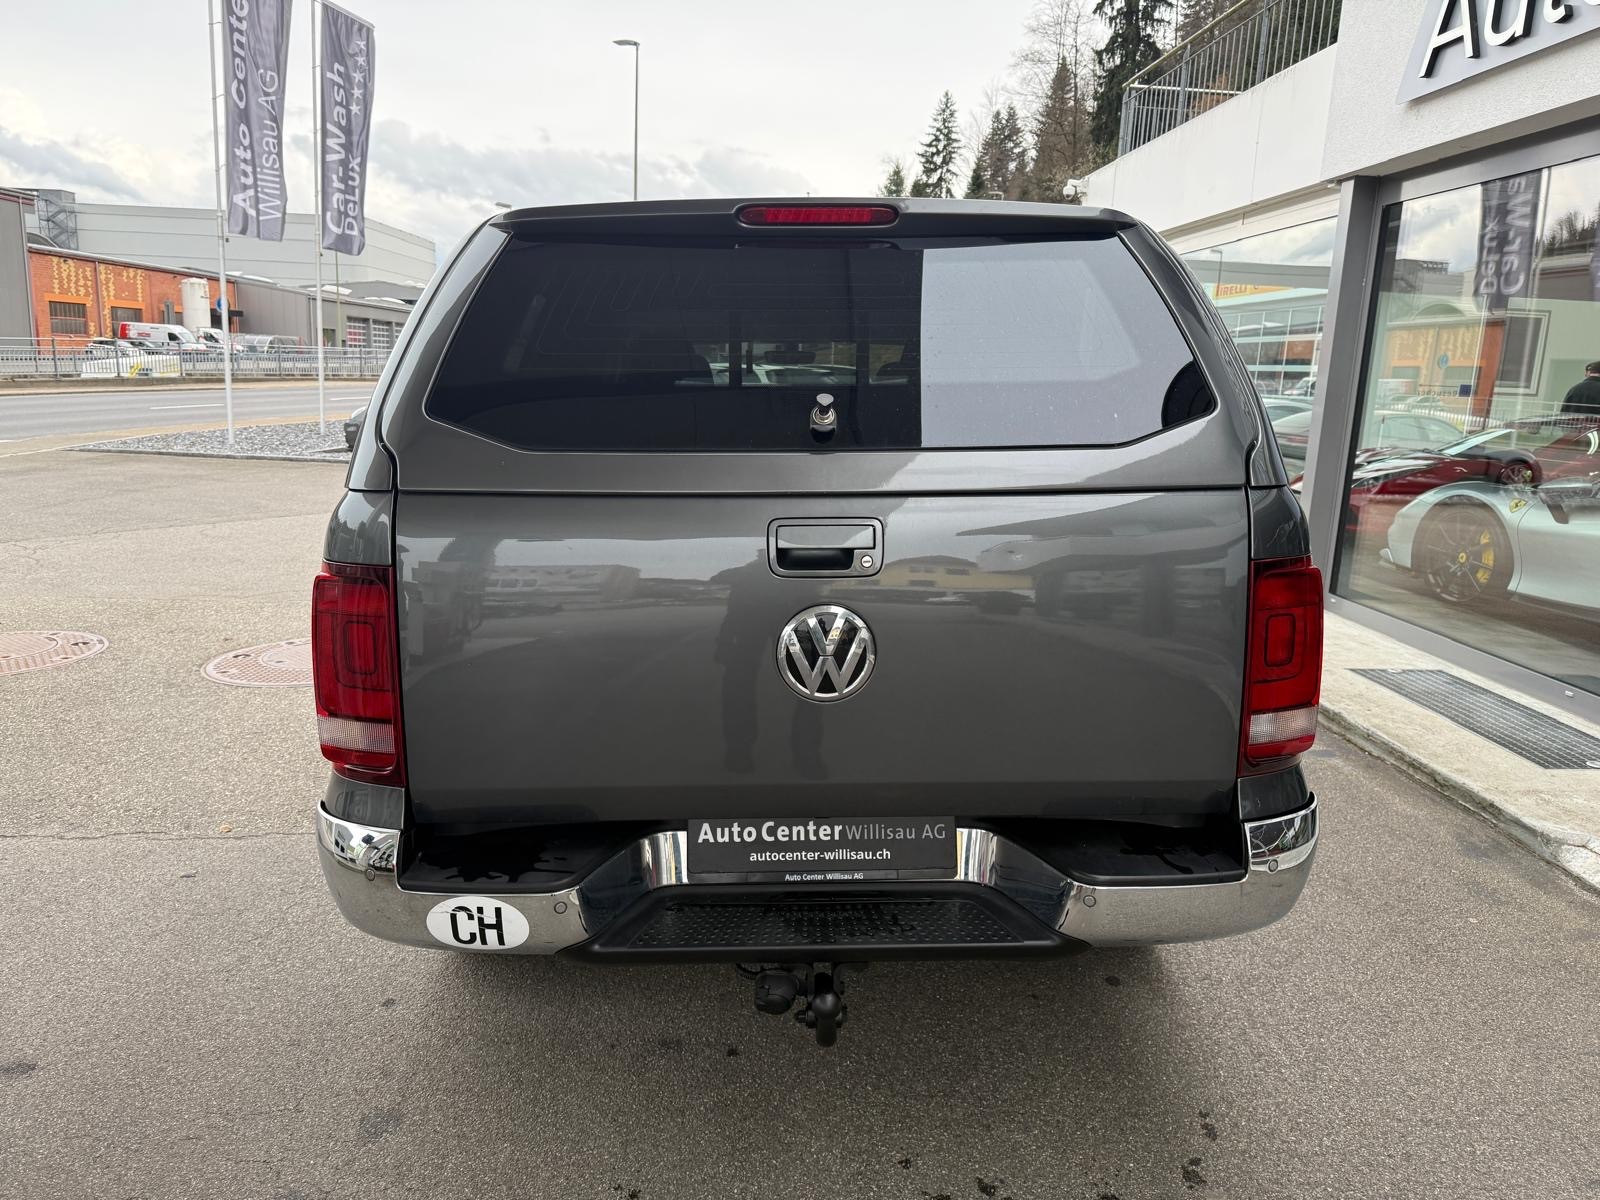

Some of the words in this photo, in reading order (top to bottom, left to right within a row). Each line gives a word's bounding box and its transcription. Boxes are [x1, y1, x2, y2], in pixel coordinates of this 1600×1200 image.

[1419, 0, 1600, 78] Au
[257, 69, 279, 118] AG
[234, 123, 256, 217] Auto
[257, 120, 282, 220] Willisau
[325, 62, 347, 235] Car-Wash
[345, 155, 361, 236] DeLux
[777, 605, 875, 700] VW
[698, 822, 757, 843] Auto
[761, 821, 843, 842] Center
[846, 824, 916, 840] Willisau
[922, 824, 946, 839] AG
[749, 849, 892, 862] autocenter-willisau.ch
[802, 873, 824, 881] Center
[825, 873, 851, 881] Willisau
[450, 905, 505, 946] CH
